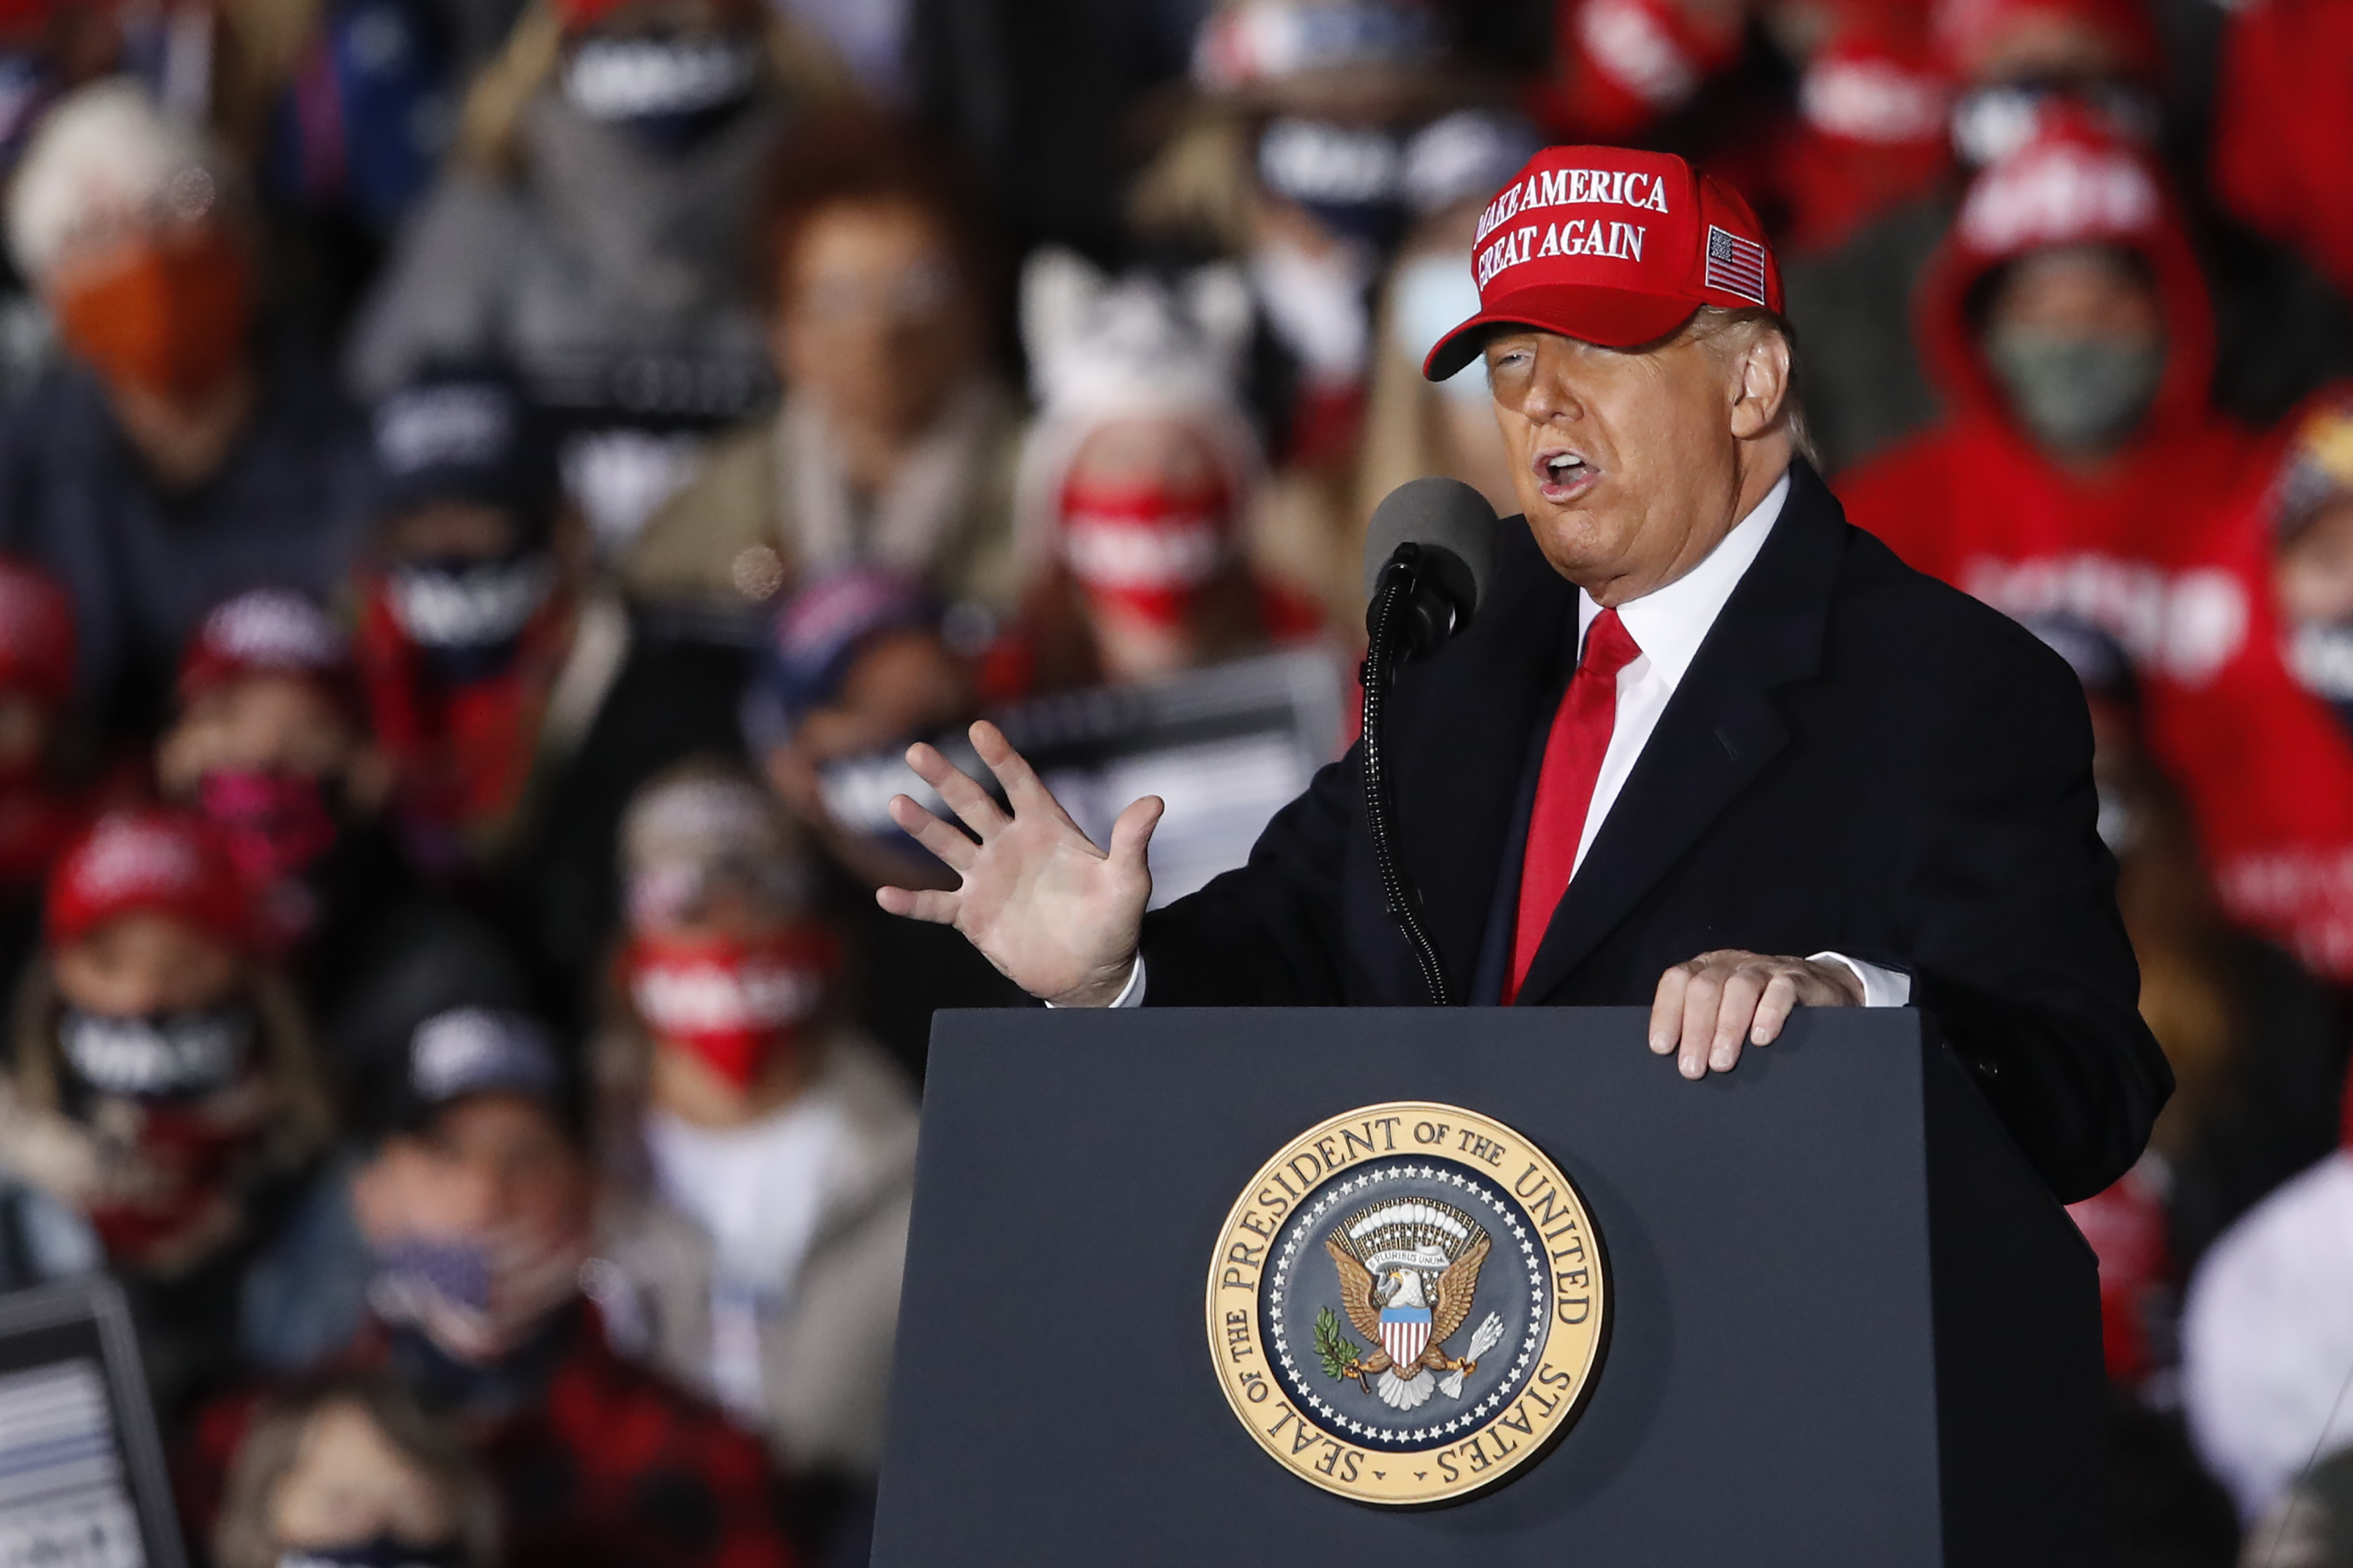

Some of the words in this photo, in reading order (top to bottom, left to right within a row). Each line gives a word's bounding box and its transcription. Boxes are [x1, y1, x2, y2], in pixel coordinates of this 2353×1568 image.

[1474, 182, 1521, 250] MAKE
[1519, 169, 1668, 213] AMERICA
[1478, 226, 1537, 292] GREAT
[1538, 220, 1646, 262] AGAIN
[1413, 1121, 1449, 1145] OF
[1458, 1128, 1506, 1167] THE
[1222, 1117, 1401, 1292] PRESIDENT
[1376, 1251, 1417, 1263] PLURIBUS
[1419, 1256, 1445, 1265] UNUM
[1514, 1164, 1590, 1325] UNITED
[1226, 1309, 1250, 1362] THE
[1238, 1370, 1269, 1403] OF
[1436, 1362, 1571, 1483] STATES
[1266, 1401, 1365, 1483] SEAL
